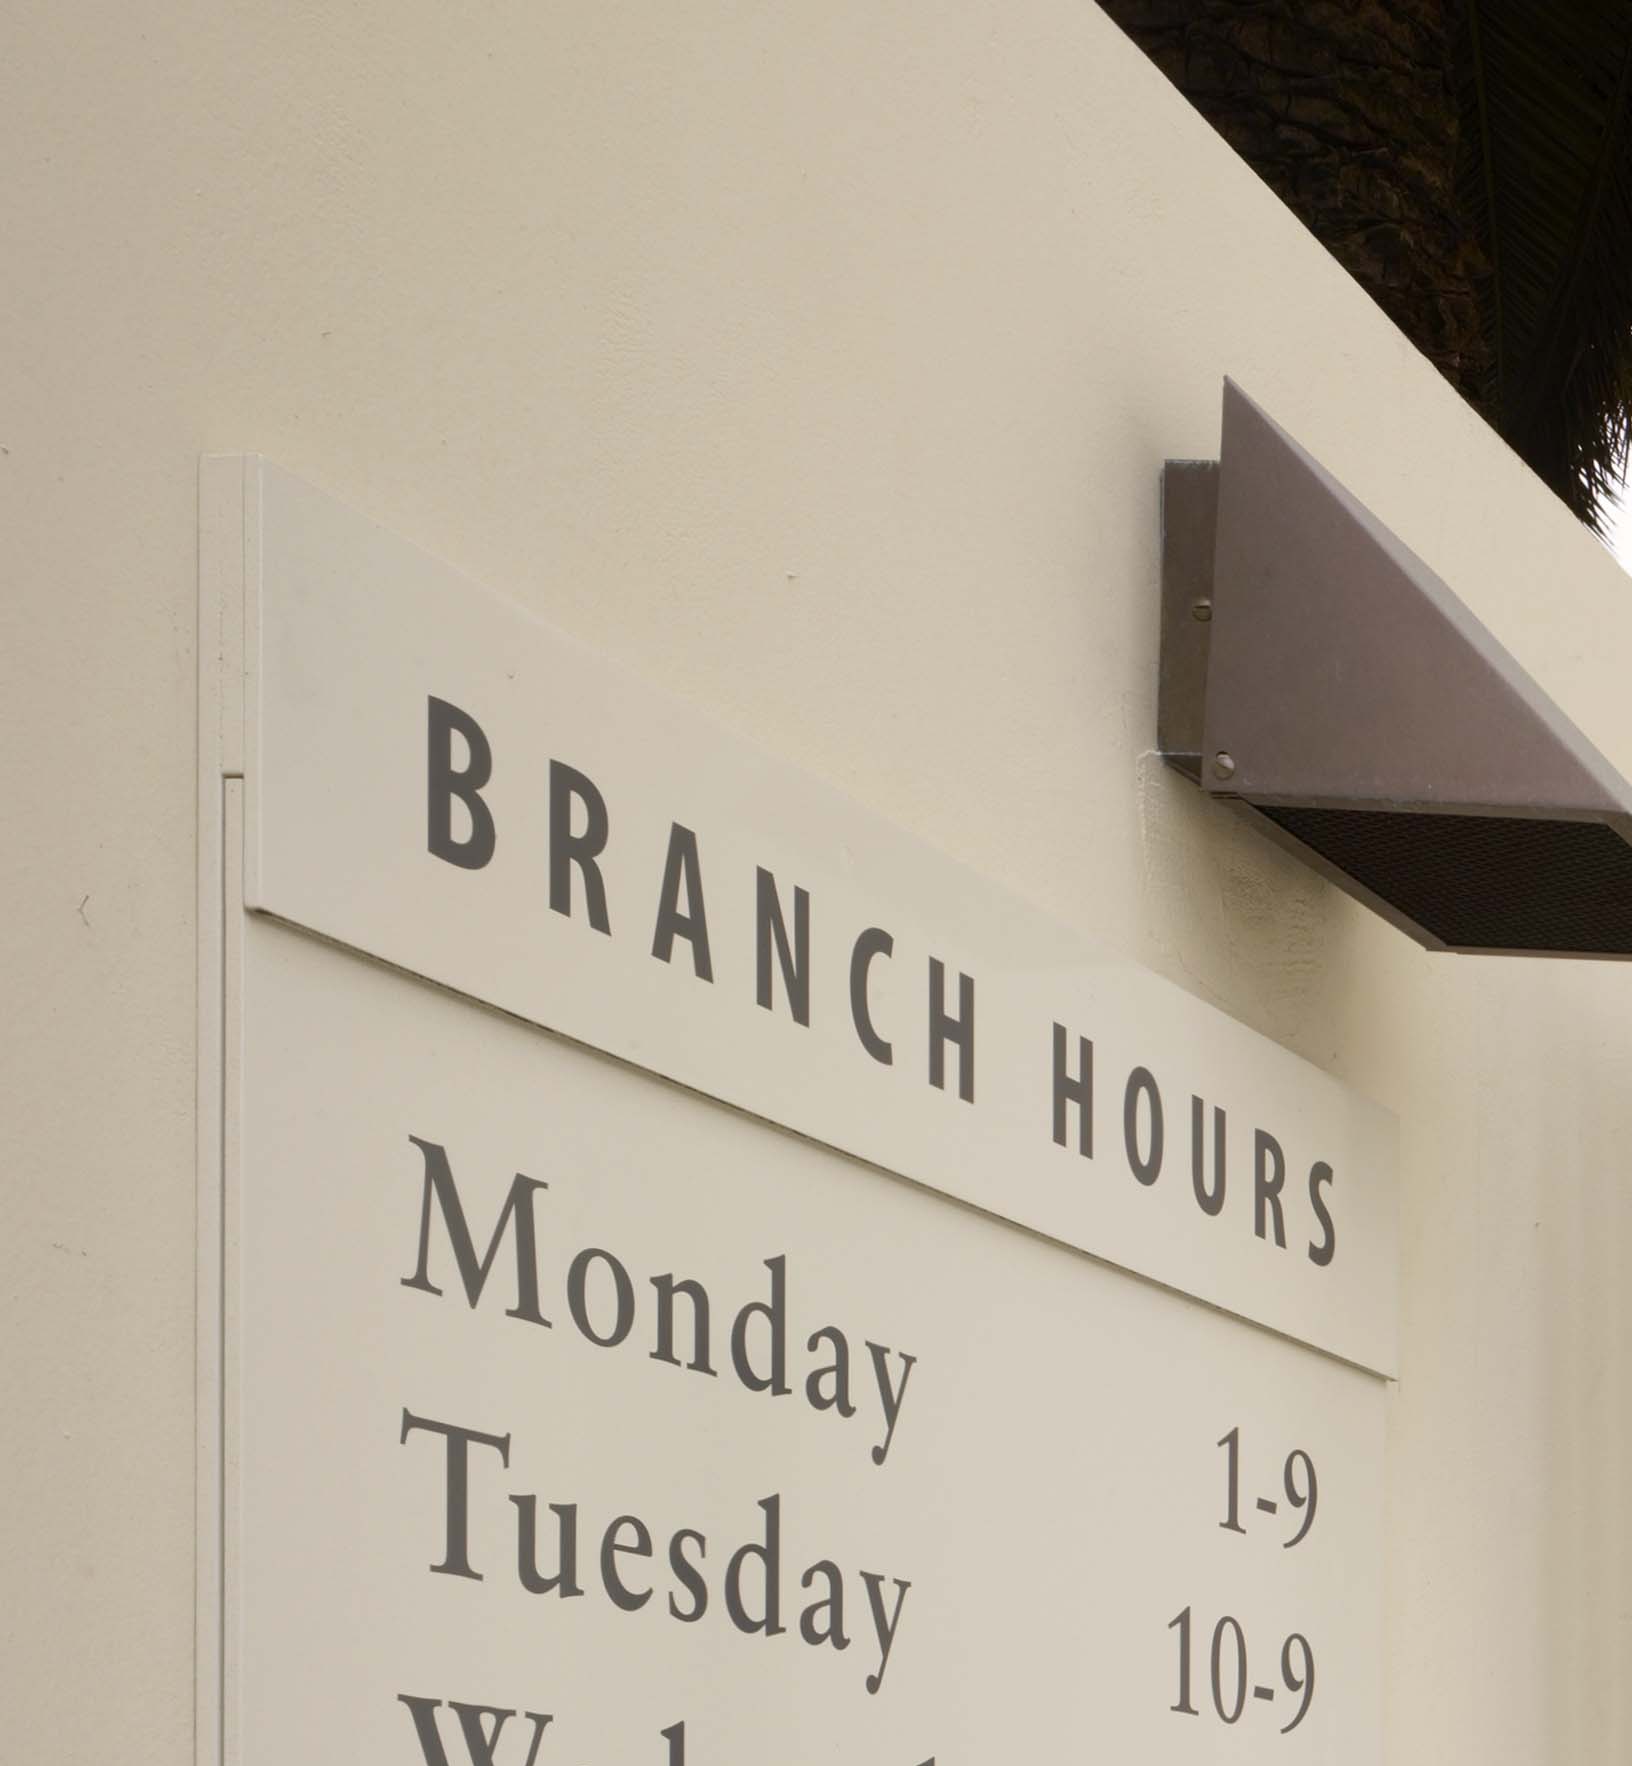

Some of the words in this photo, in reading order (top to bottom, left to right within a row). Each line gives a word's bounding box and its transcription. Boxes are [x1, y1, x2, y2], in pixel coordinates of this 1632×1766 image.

[426, 693, 976, 1106] BRANCH
[1051, 1020, 1337, 1268] HOURS
[399, 1133, 919, 1467] Monday
[1216, 1425, 1319, 1550] 1-9
[398, 1406, 913, 1696] Tuesday
[1166, 1604, 1316, 1736] 10-9
